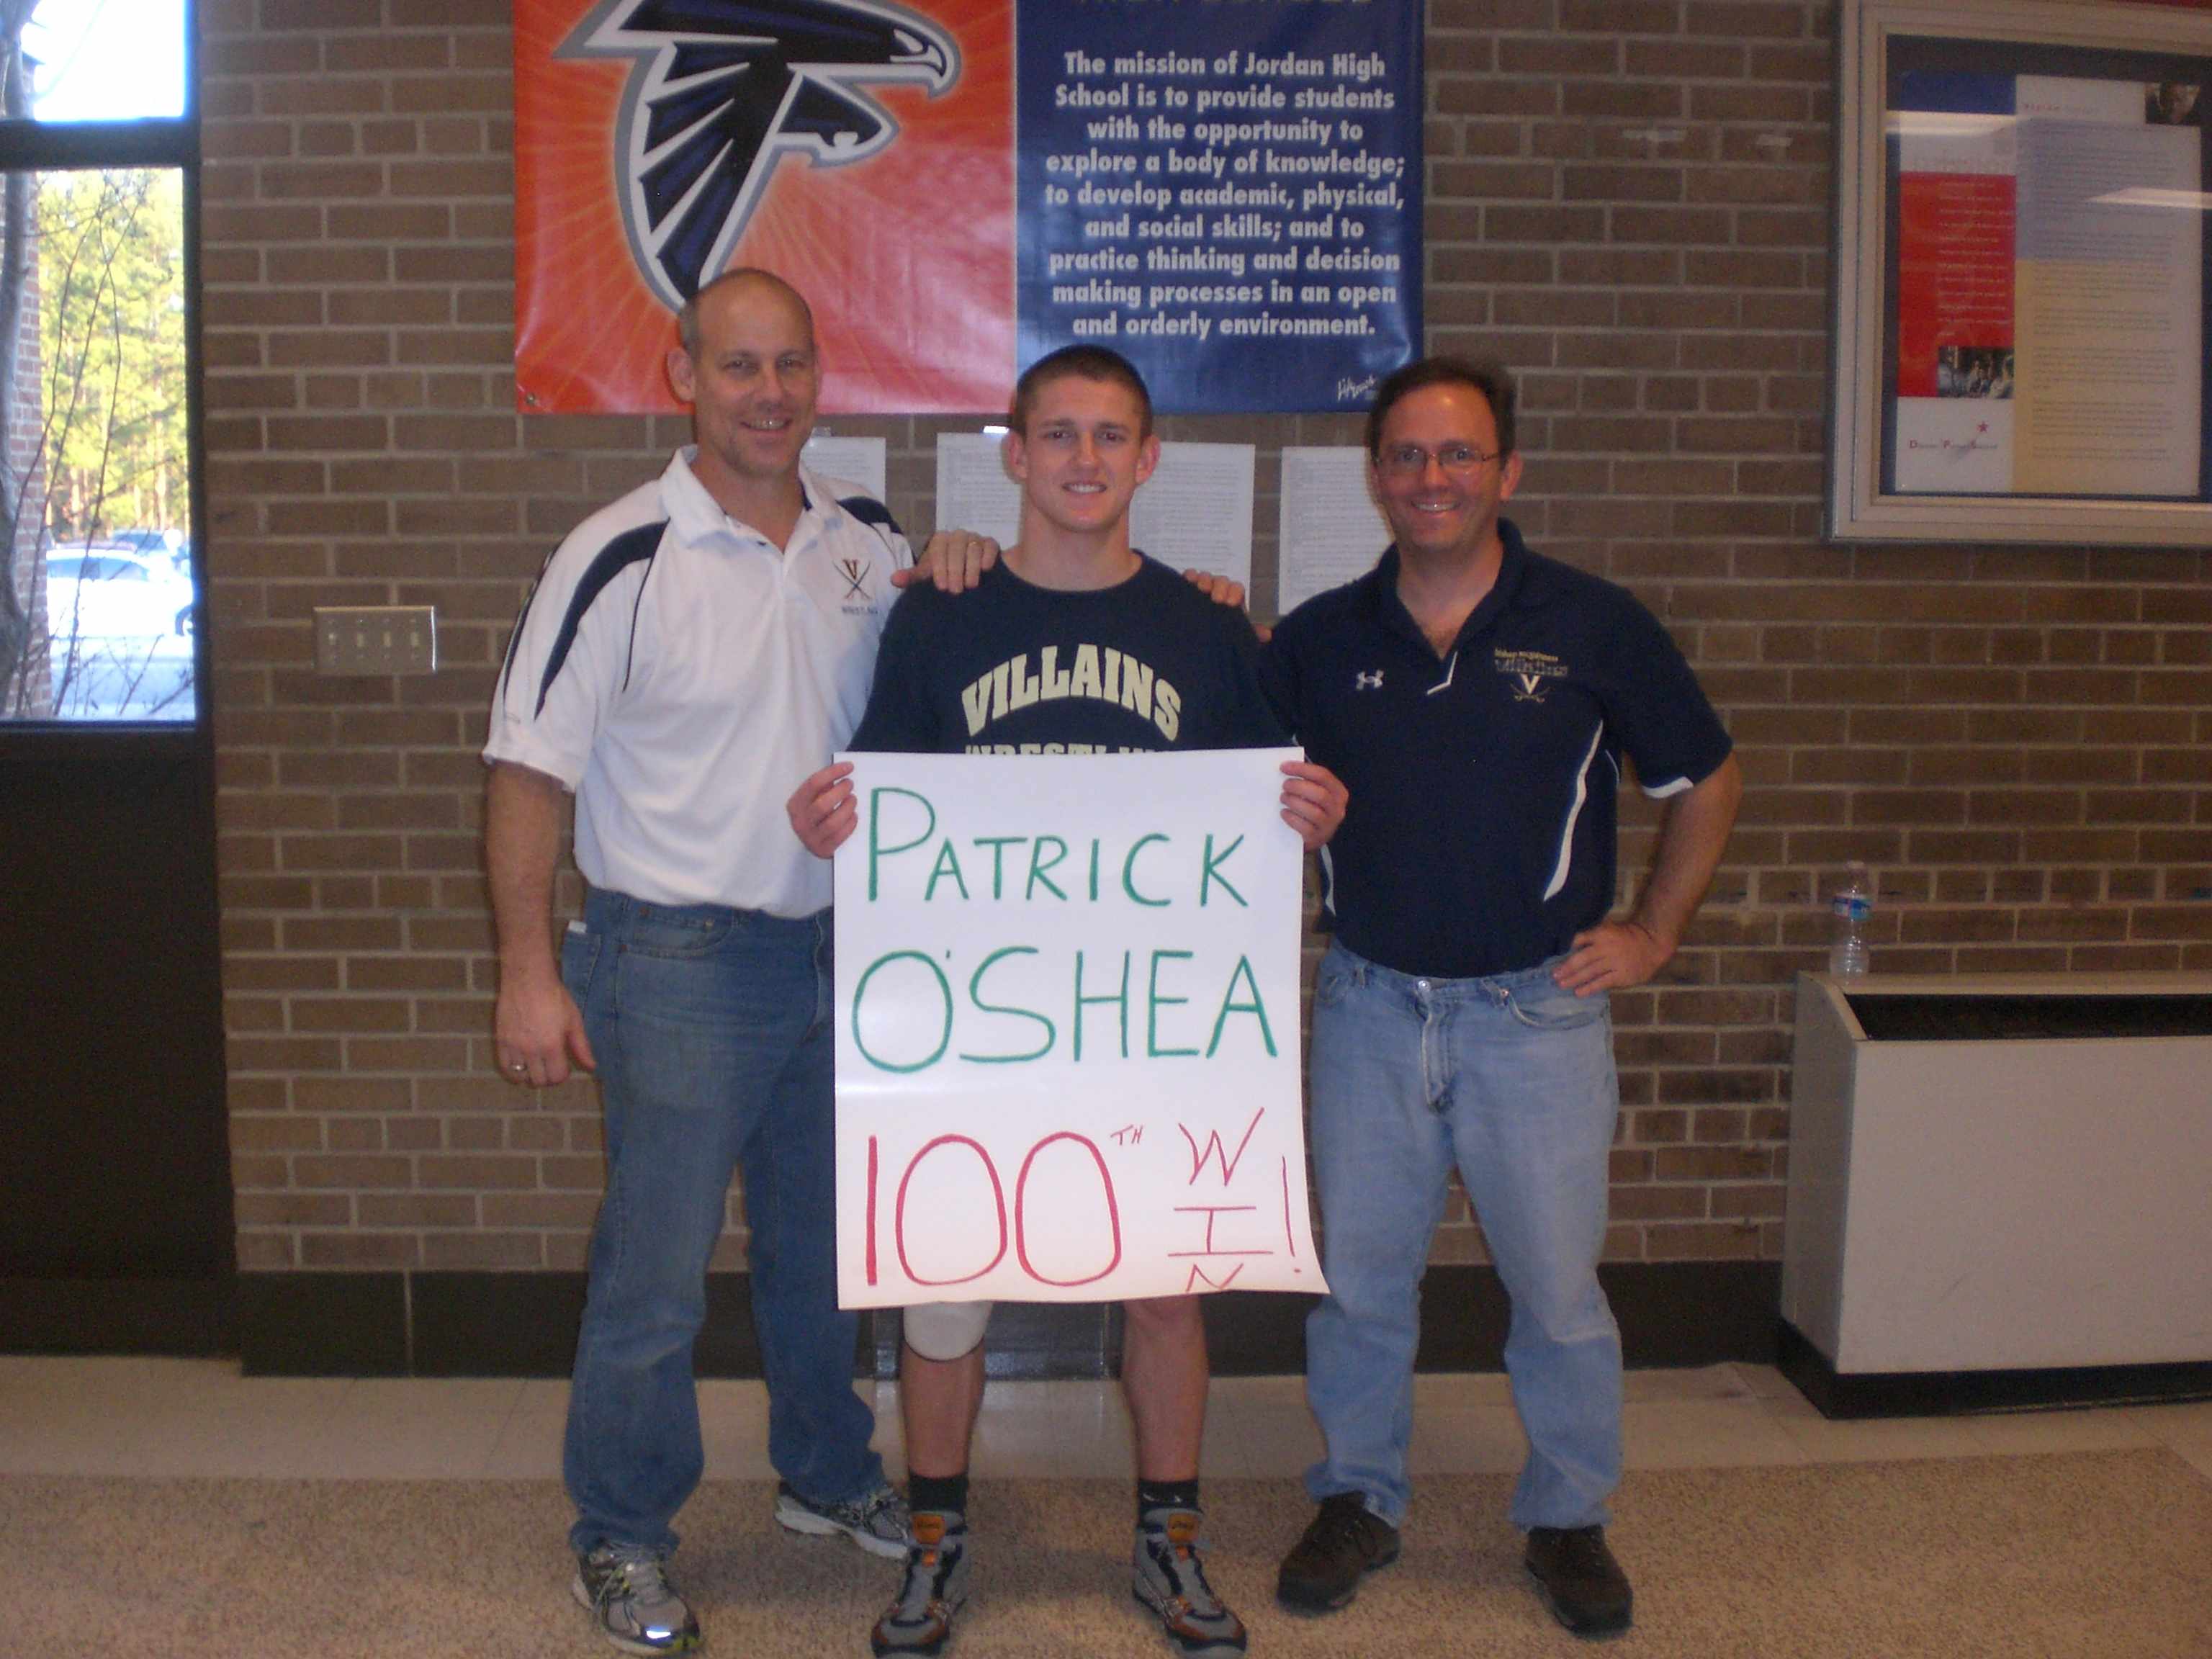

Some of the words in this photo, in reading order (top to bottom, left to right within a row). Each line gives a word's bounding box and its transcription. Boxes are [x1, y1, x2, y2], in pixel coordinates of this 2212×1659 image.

[1065, 51, 1105, 73] The
[1115, 51, 1205, 73] mission
[1214, 50, 1237, 73] of
[1245, 53, 1323, 75] Jordan
[1333, 53, 1385, 81] High
[1056, 83, 1128, 106] School
[1138, 84, 1156, 106] is
[1165, 87, 1188, 106] to
[1197, 84, 1285, 112] provide
[1295, 85, 1394, 108] students
[1088, 115, 1139, 139] with
[1148, 115, 1185, 139] the
[1195, 117, 1331, 146] opportunity
[1340, 121, 1362, 140] to
[1046, 148, 1136, 179] explore
[1146, 156, 1159, 172] a
[1169, 148, 1226, 178] body
[1234, 149, 1258, 172] of
[1266, 149, 1404, 179] knowledge;
[1045, 184, 1069, 207] to
[1077, 180, 1171, 211] develop
[1180, 182, 1294, 210] academic,
[1303, 181, 1403, 210] physical,
[1084, 213, 1129, 238] and
[1138, 214, 1203, 238] social
[1213, 214, 1281, 242] skills;
[1290, 215, 1332, 237] and
[1341, 218, 1364, 238] to
[1048, 247, 1138, 277] practice
[1147, 246, 1245, 276] thinking
[1254, 246, 1297, 269] and
[1306, 246, 1400, 271] decision
[1053, 279, 1141, 310] making
[1149, 287, 1262, 309] processes
[1272, 279, 1292, 302] in
[1301, 287, 1329, 302] an
[1339, 287, 1397, 308] open
[1073, 311, 1117, 336] and
[1125, 311, 1210, 341] orderly
[1220, 312, 1375, 335] environment.
[961, 643, 1181, 741] VILLAINS
[867, 786, 1249, 908] PATRICK
[852, 945, 1278, 1074] O'SHEA
